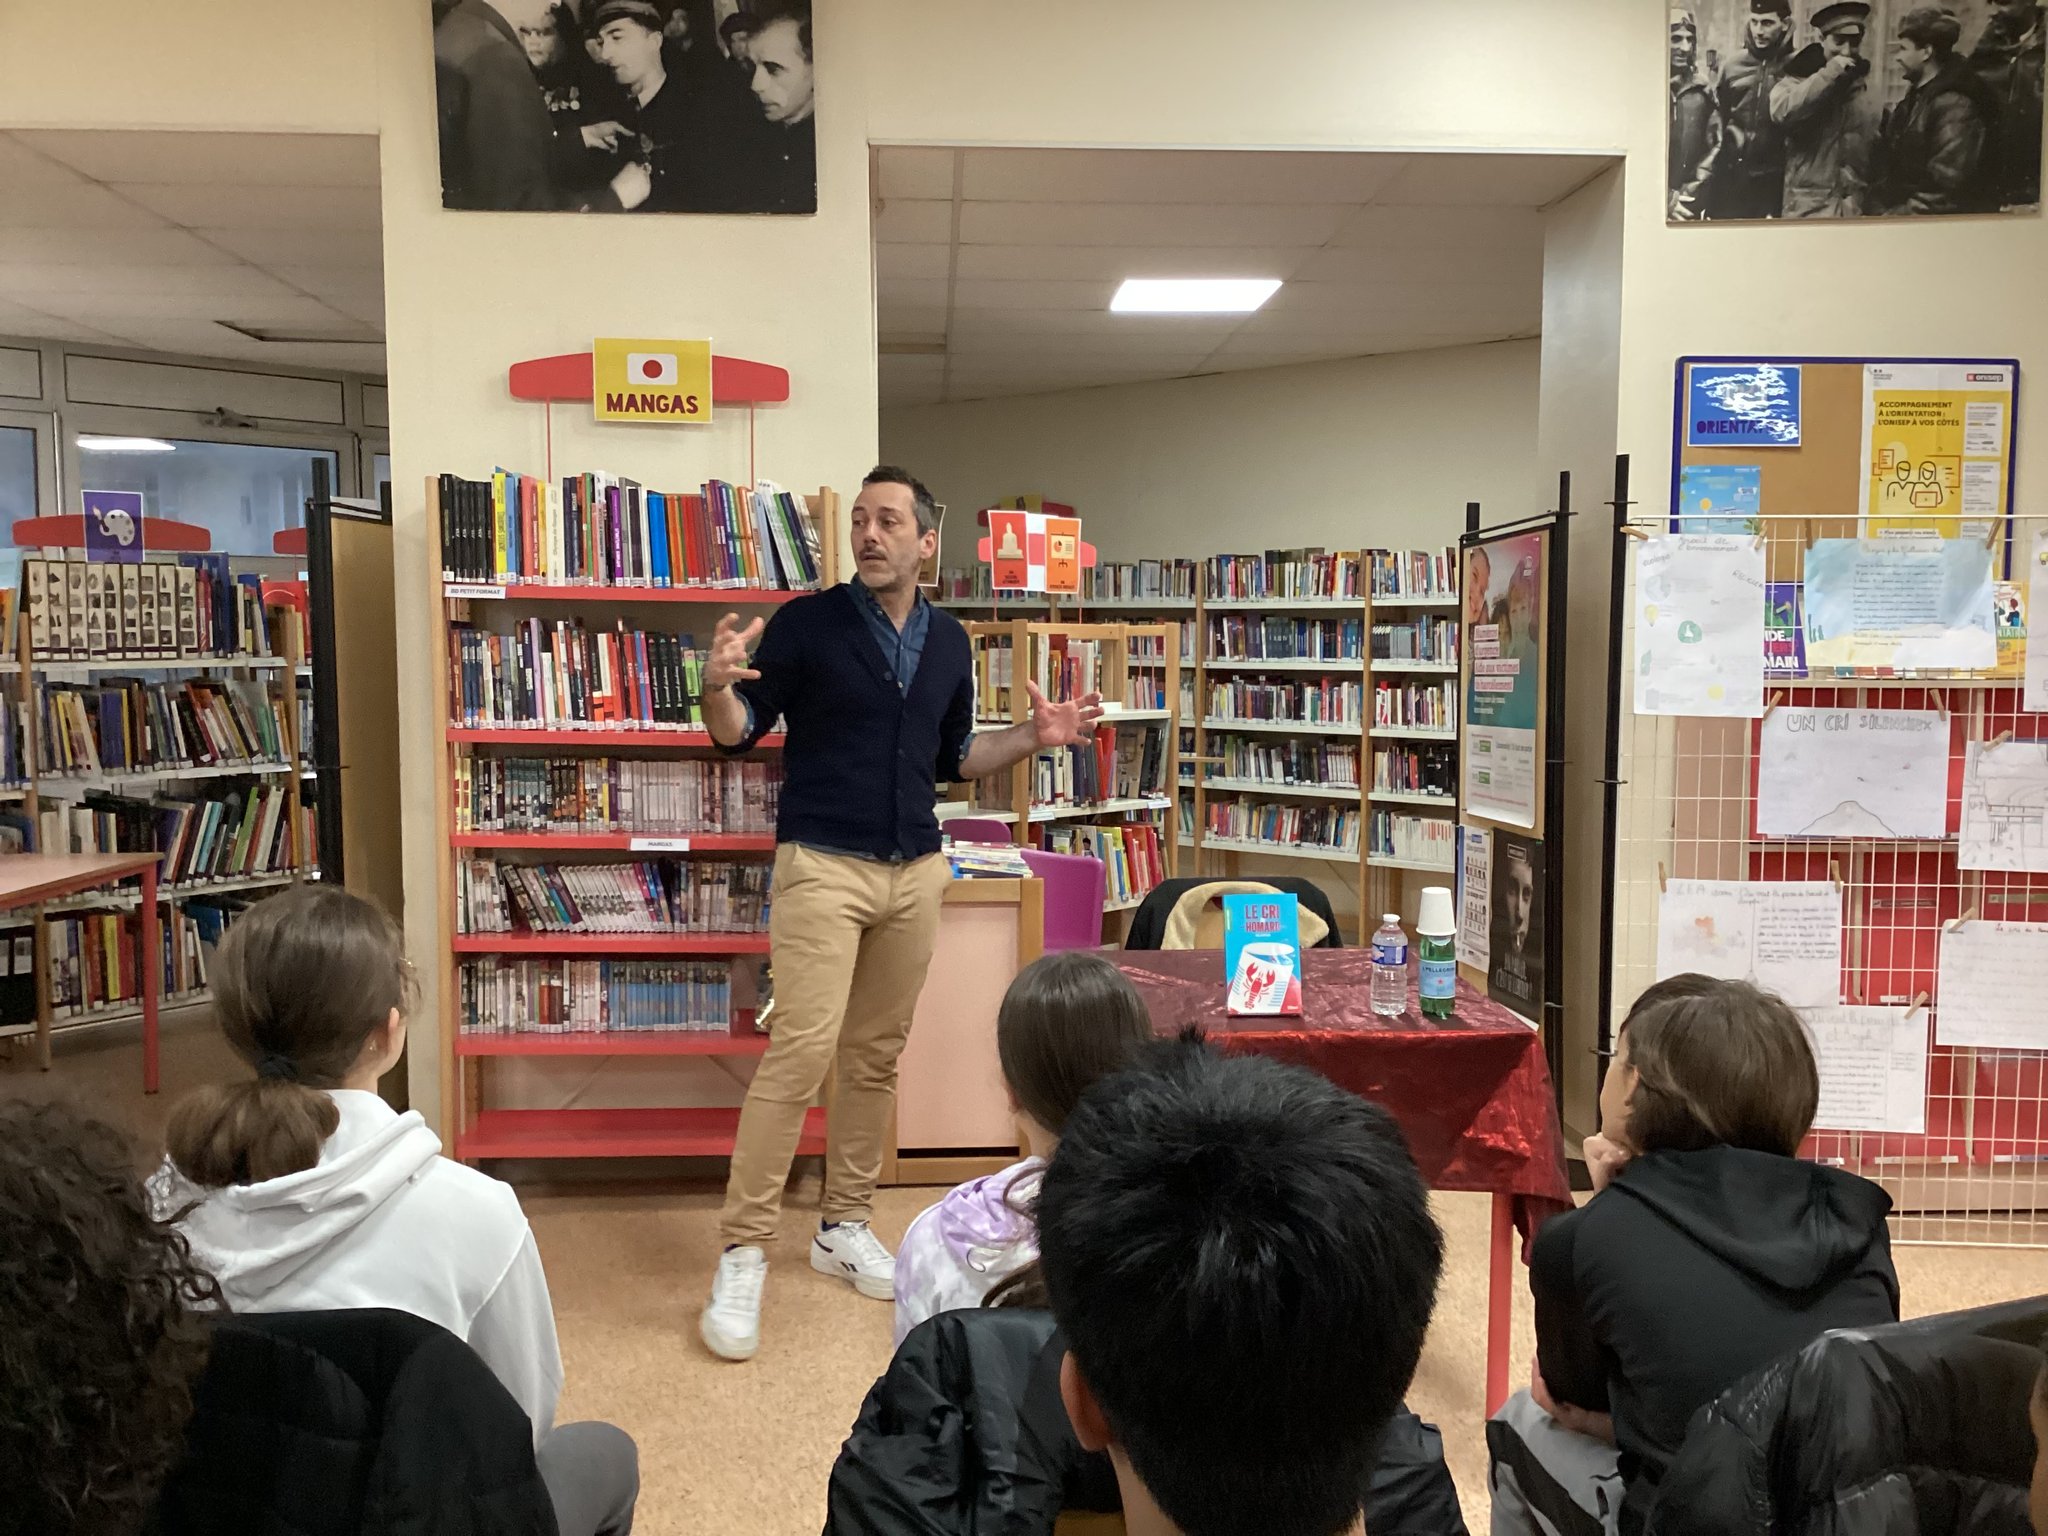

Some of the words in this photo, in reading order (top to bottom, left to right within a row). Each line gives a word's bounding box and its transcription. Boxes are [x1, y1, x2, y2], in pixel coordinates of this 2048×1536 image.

[606, 393, 699, 414] MANGAS
[1696, 420, 1772, 434] ORIENTA
[1764, 630, 1786, 641] IDE
[1763, 655, 1800, 668] MAIN
[1786, 714, 1816, 733] UN
[1824, 713, 1849, 731] CRI
[1245, 904, 1259, 919] LE
[1261, 904, 1280, 919] CRI
